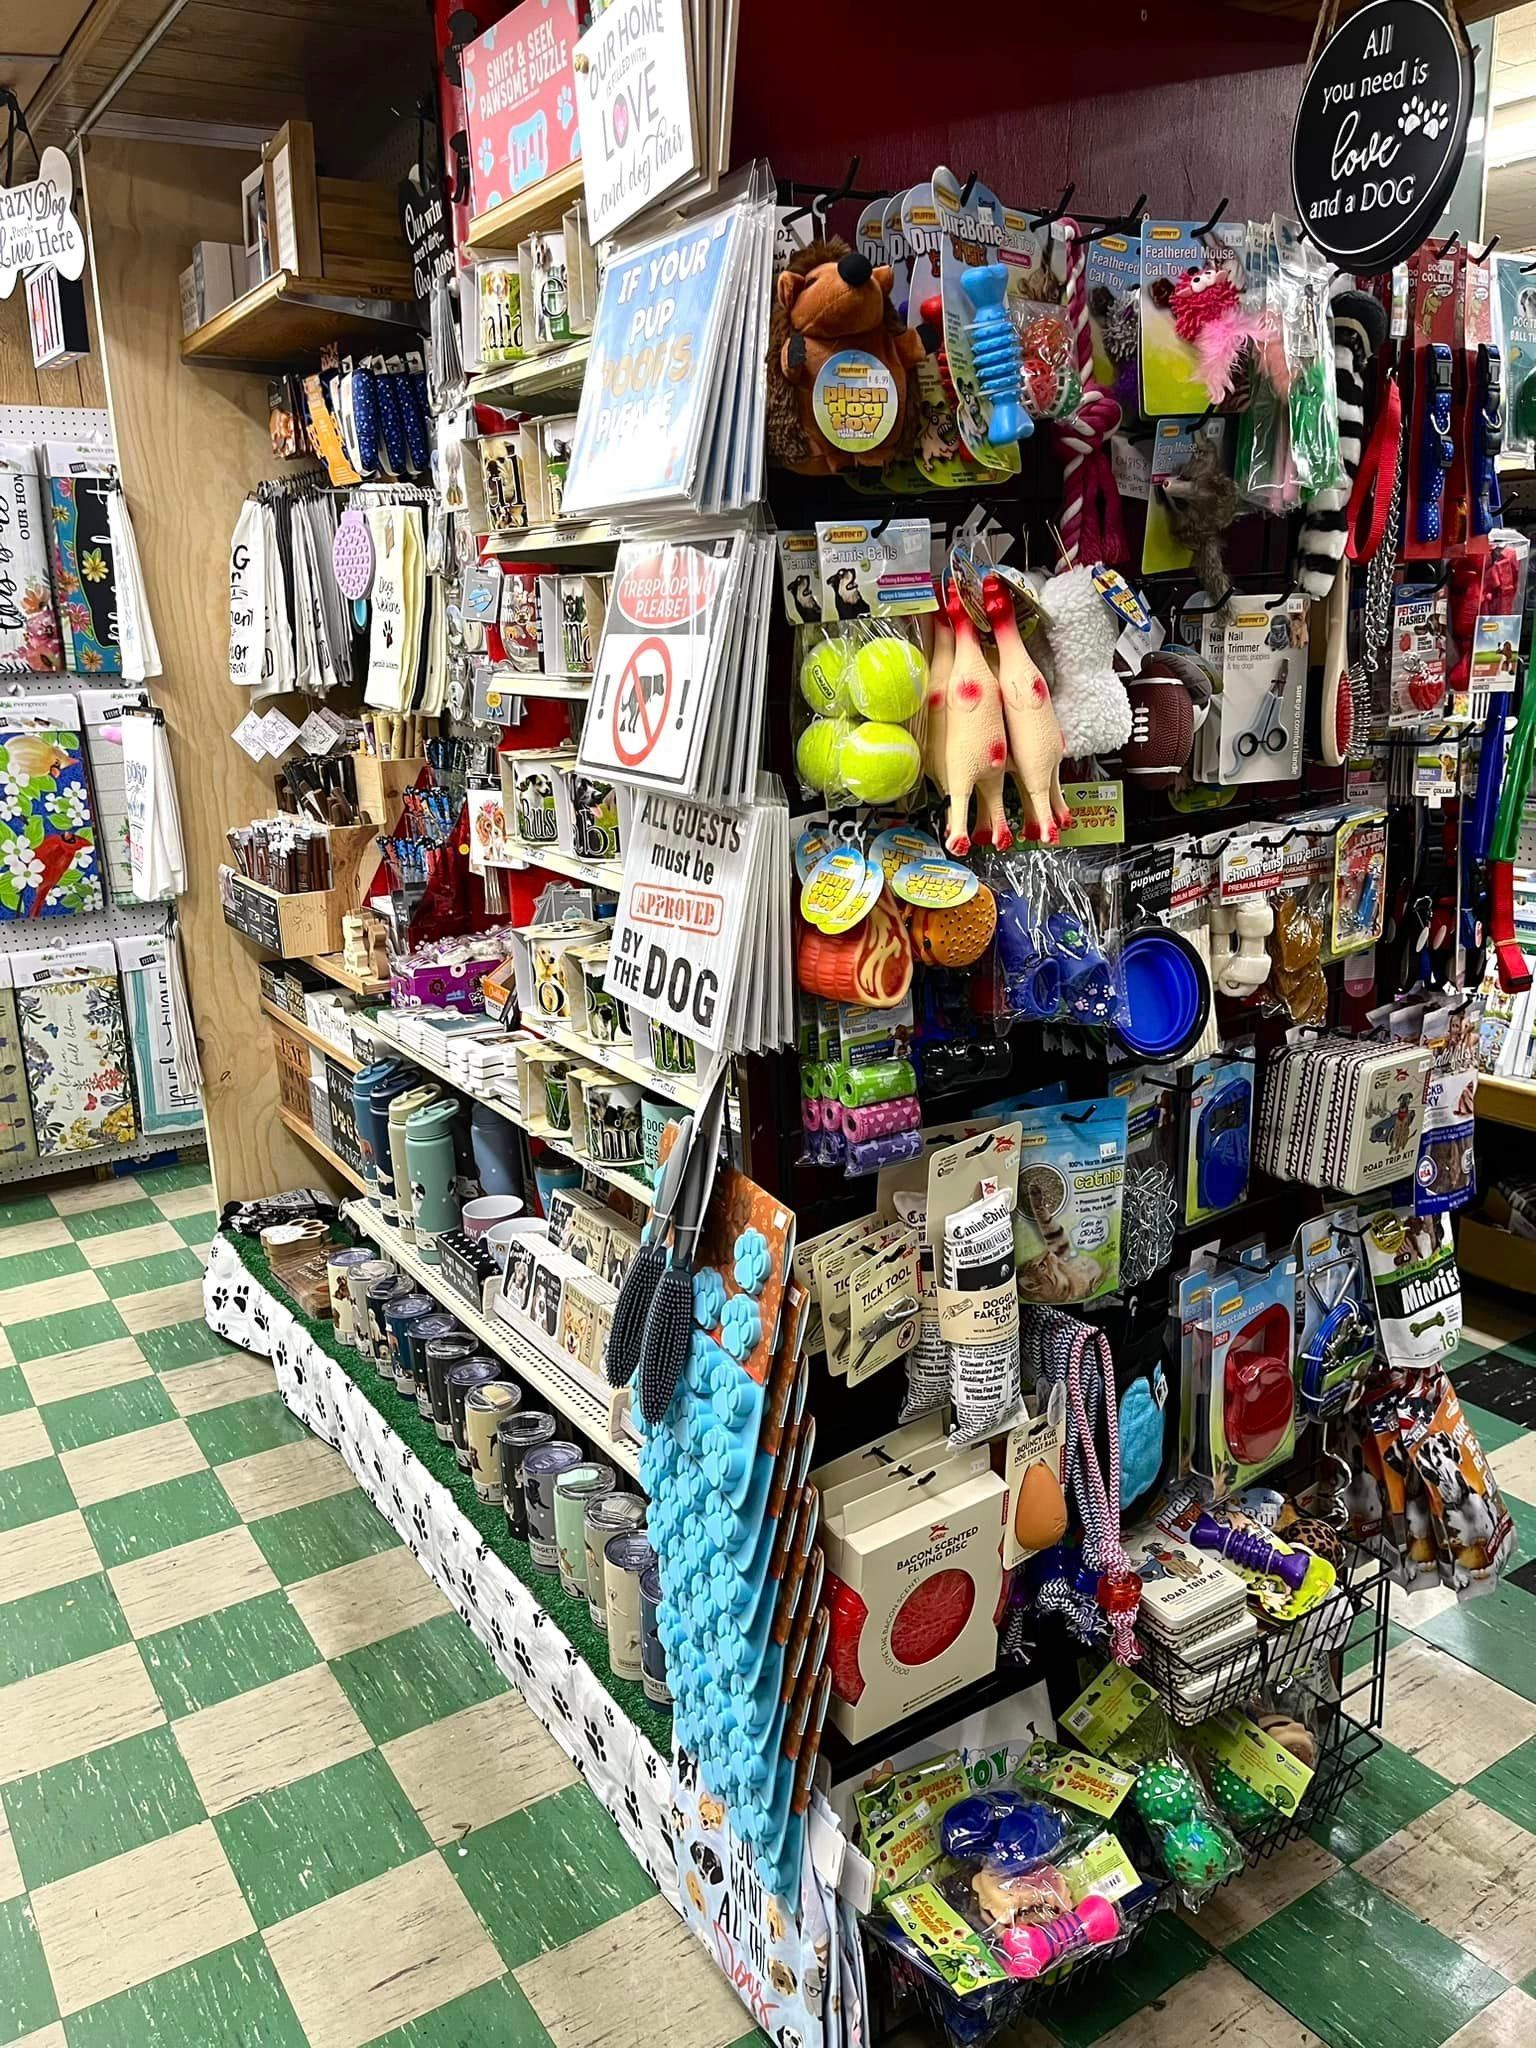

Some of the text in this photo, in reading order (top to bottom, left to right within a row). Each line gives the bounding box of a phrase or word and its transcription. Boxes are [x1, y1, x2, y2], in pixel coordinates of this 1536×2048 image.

[487, 17, 555, 86] SNIFF & SEEK
[590, 1, 665, 101] OUR HOME
[1362, 24, 1395, 60] All
[630, 47, 647, 67] WITH
[480, 69, 529, 121] PAWSOME
[529, 39, 568, 87] PUZZLE
[1322, 57, 1430, 114] you need is
[602, 60, 660, 162] LOVE
[1331, 109, 1402, 181] love
[593, 175, 627, 223] and
[628, 150, 653, 197] dog
[1309, 175, 1417, 219] and a DOG
[0, 179, 67, 232] razy Dog
[35, 227, 75, 259] Here
[1145, 246, 1235, 260] Feathered Mouse
[617, 237, 710, 306] IF YOUR
[1091, 251, 1140, 275] Feathered
[1145, 262, 1185, 277] Cat Toy
[1088, 268, 1124, 289] Cat Toy
[1421, 273, 1454, 285] COLLAR
[629, 297, 676, 345] PUP
[823, 383, 889, 405] plush
[827, 399, 885, 418] dog
[830, 412, 882, 434] toy
[18, 507, 32, 541] OUR
[784, 556, 817, 570] Tennis
[823, 546, 898, 564] Tennis Balls
[634, 597, 688, 619] PLEASE!
[1398, 613, 1427, 627] FLASHER
[1228, 631, 1244, 642] Nail
[1228, 643, 1260, 653] Trimmer
[1070, 805, 1111, 818] UEAKY
[640, 794, 742, 854] ALL GUESTS
[651, 842, 715, 885] must be
[1226, 858, 1282, 883] chomp'ems
[1130, 868, 1171, 892] pupware
[1227, 880, 1257, 892] PREMIUM
[635, 891, 716, 927] APPROVED
[613, 954, 642, 993] THE
[621, 927, 720, 1029] BY DOG
[646, 1118, 665, 1134] DOG
[1363, 1149, 1415, 1173] ROAD TRIP KIT
[1074, 1168, 1124, 1190] catnip
[833, 1276, 850, 1294] TIC
[861, 1281, 884, 1308] TICK
[885, 1264, 912, 1290] TOOL
[982, 1289, 1014, 1311] DOGGY
[973, 1307, 1001, 1321] FAKE
[993, 1311, 1013, 1327] TOY
[1440, 1331, 1457, 1351] 16
[959, 1358, 985, 1369] Climate
[1017, 1428, 1057, 1455] BOUNCY EGG
[1014, 1452, 1027, 1464] DOG
[896, 1525, 979, 1572] BACON SCENTED
[907, 1540, 968, 1575] FLYING DISC
[1160, 1569, 1224, 1603] ROAD TRIP KIT
[882, 1603, 901, 1635] BACON
[748, 1919, 768, 1982] THE
